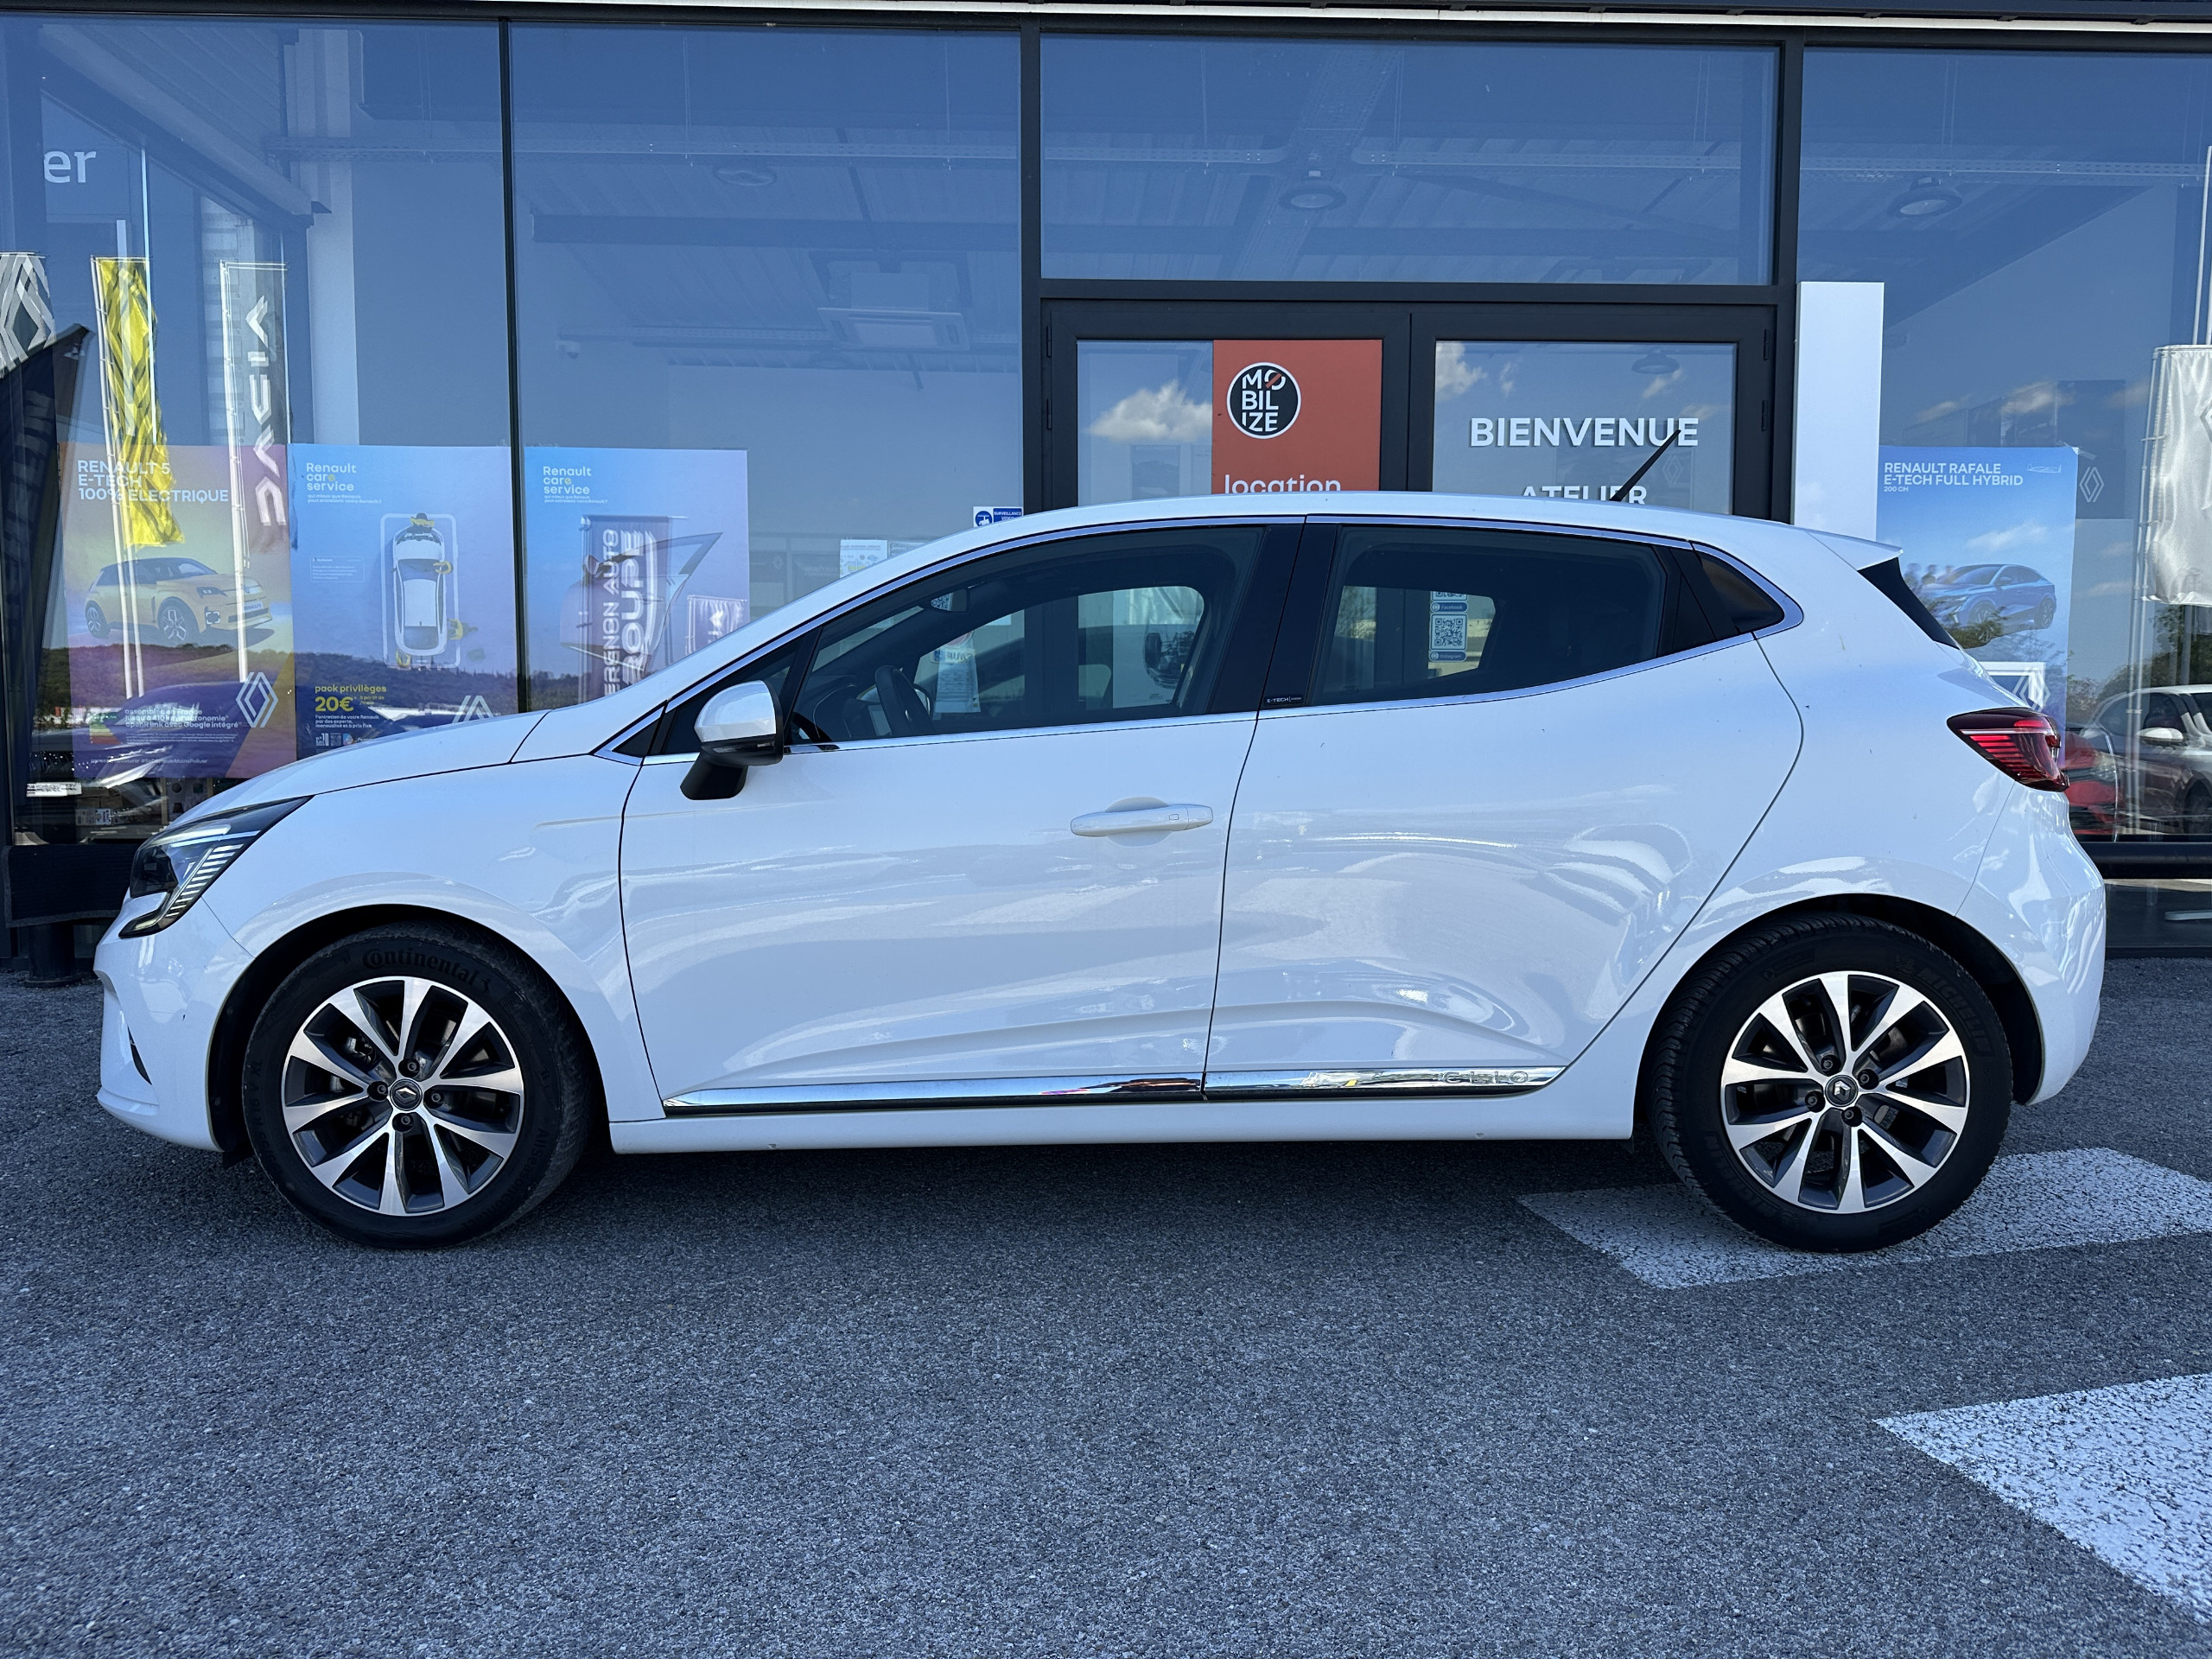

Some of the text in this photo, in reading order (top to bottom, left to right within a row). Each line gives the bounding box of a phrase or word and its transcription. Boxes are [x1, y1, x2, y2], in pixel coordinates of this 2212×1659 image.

[1471, 418, 1699, 446] BIENVENUE
[77, 460, 171, 474] RENAULT 5
[306, 463, 356, 474] Renault
[543, 466, 592, 476] Renault
[1884, 463, 2001, 474] RENAULT RAFALE
[78, 474, 142, 487] E-TECH
[307, 481, 354, 491] service
[543, 477, 572, 486] care
[1225, 474, 1341, 494] location
[1884, 475, 2024, 486] E-TECH FULL HYBRID
[78, 487, 124, 501] 100%
[543, 484, 589, 494] service
[603, 529, 620, 594] AUTO
[315, 684, 387, 695] pack privilèges
[362, 948, 479, 987] Continental
[1918, 968, 1987, 1051] MICHELIN
[1442, 1071, 1529, 1084] CLIO
